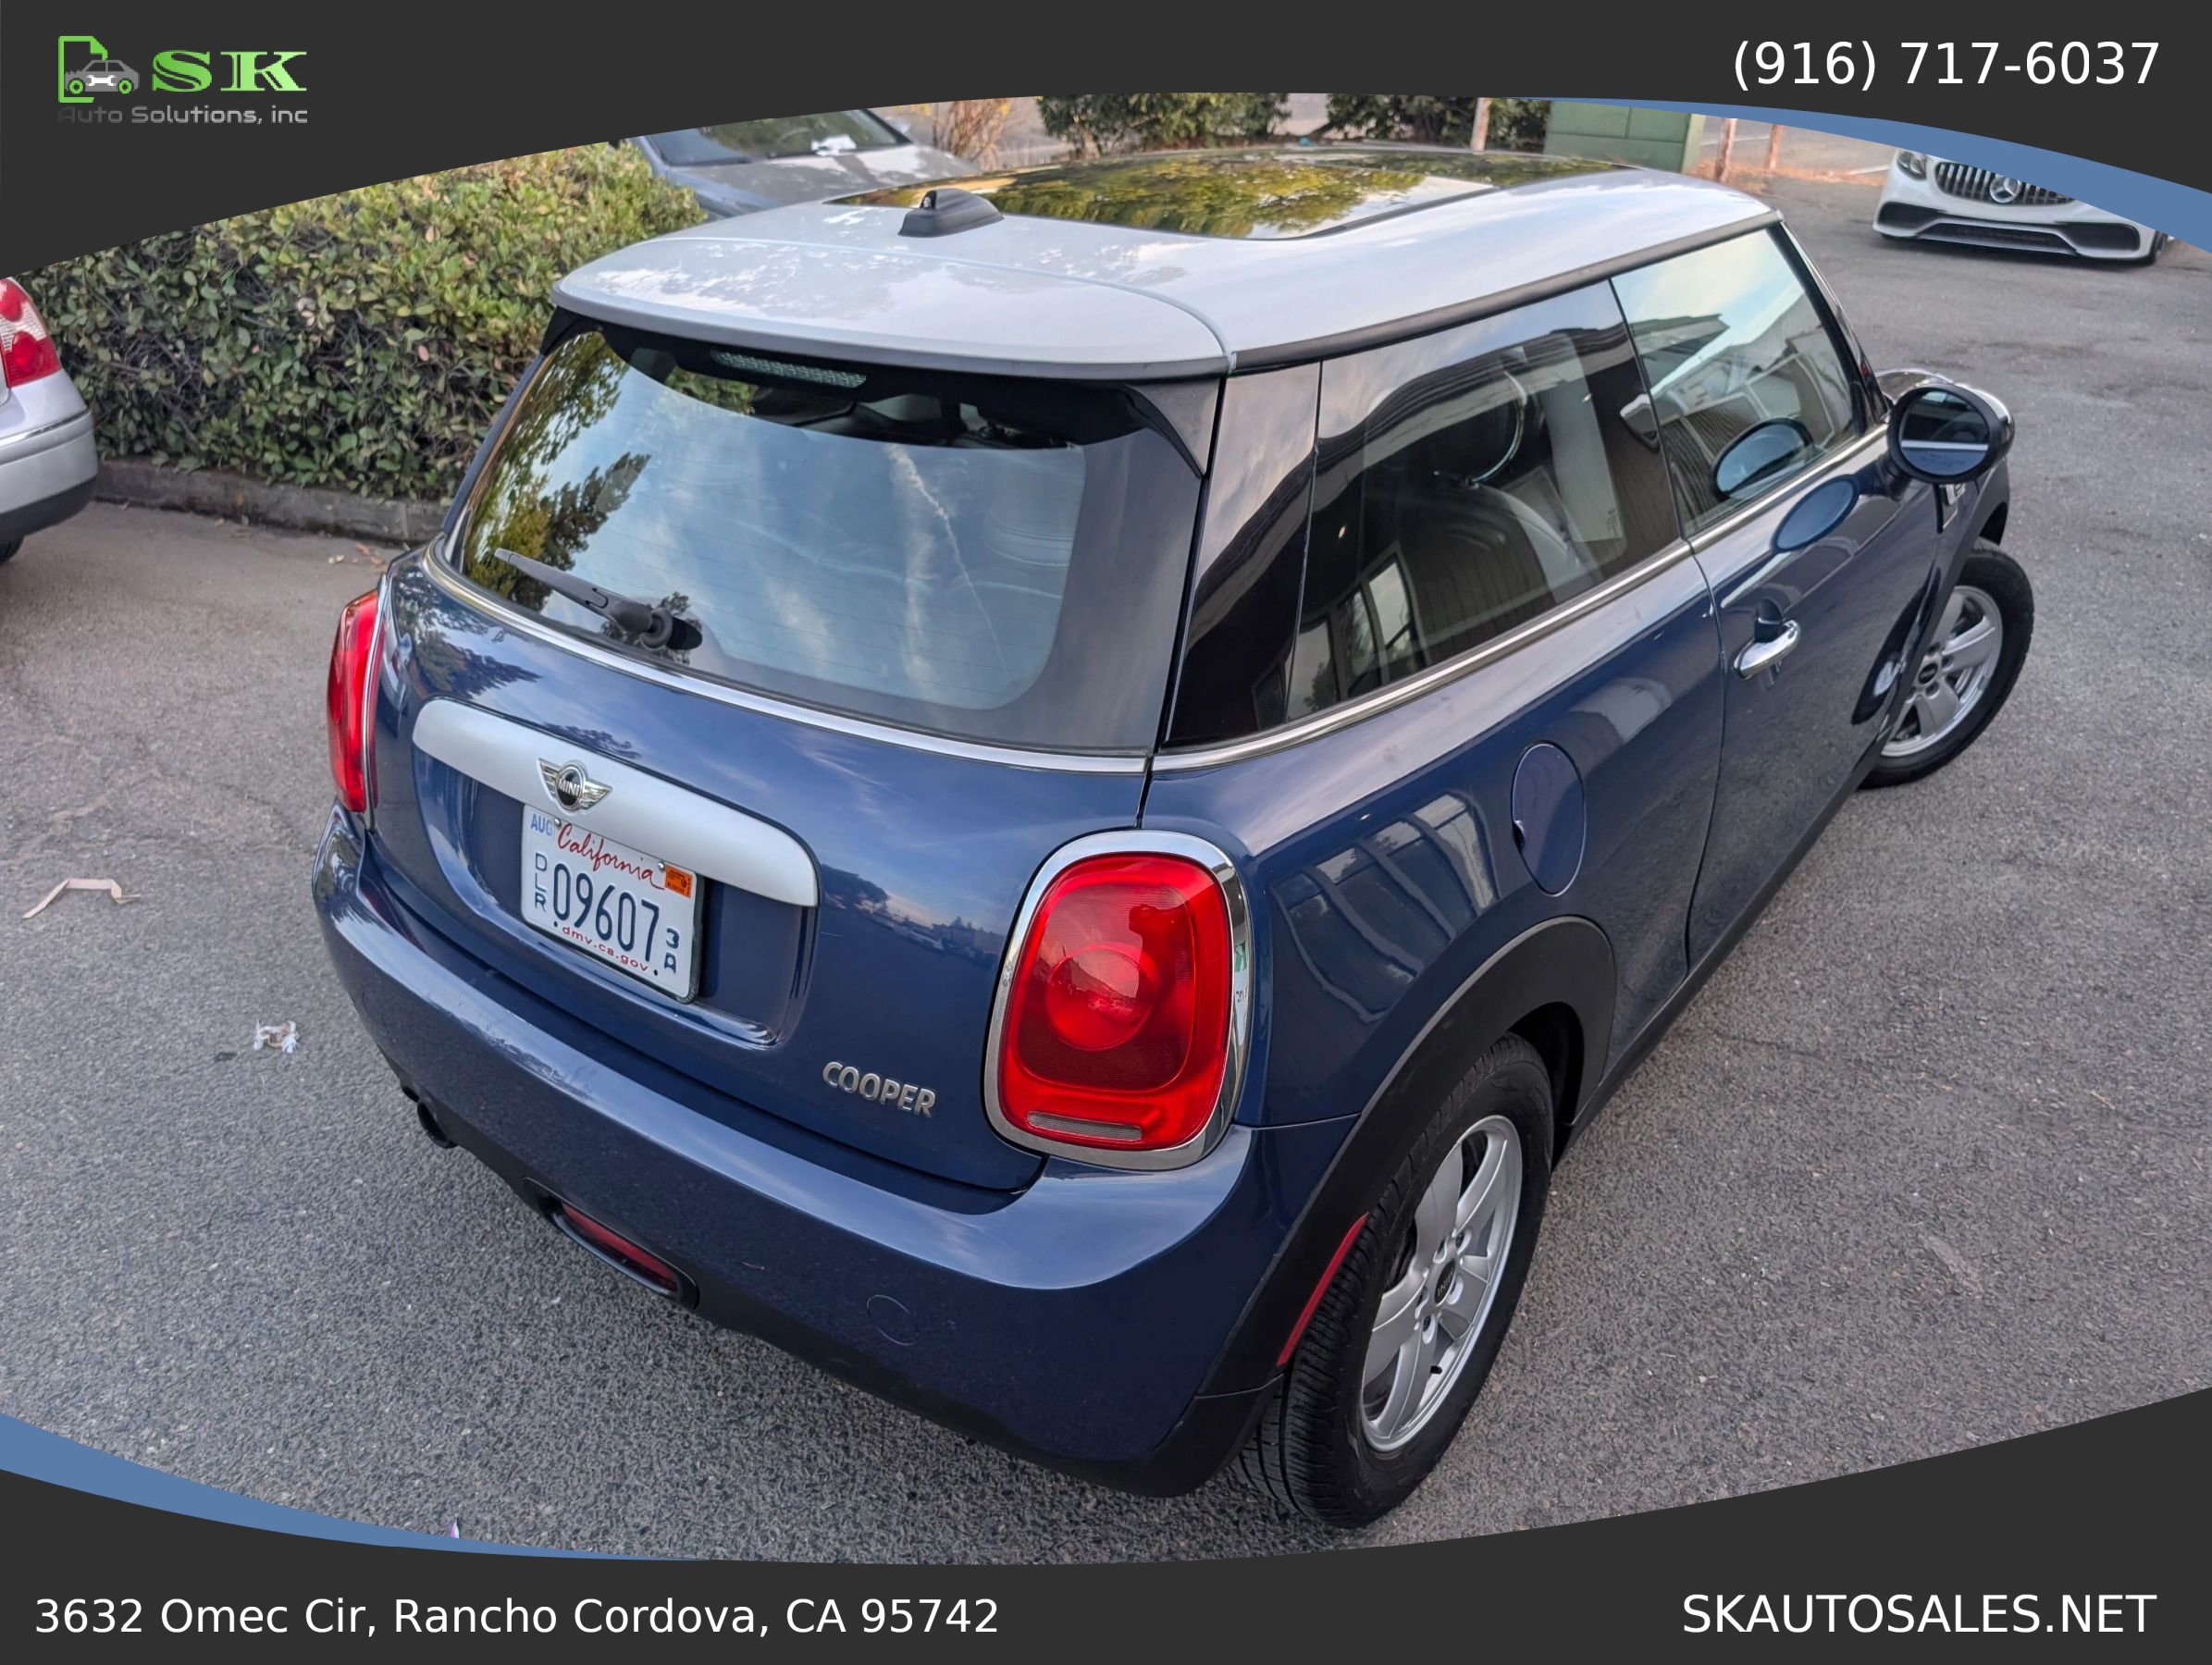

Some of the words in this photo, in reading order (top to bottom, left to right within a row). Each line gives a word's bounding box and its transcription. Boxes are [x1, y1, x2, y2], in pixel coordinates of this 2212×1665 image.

[558, 779, 581, 796] MINI
[530, 813, 553, 837] AUG
[558, 822, 666, 891] California
[552, 862, 661, 963] 09607
[562, 925, 649, 973] dmv.ca.gov
[822, 1061, 937, 1118] COOPER
